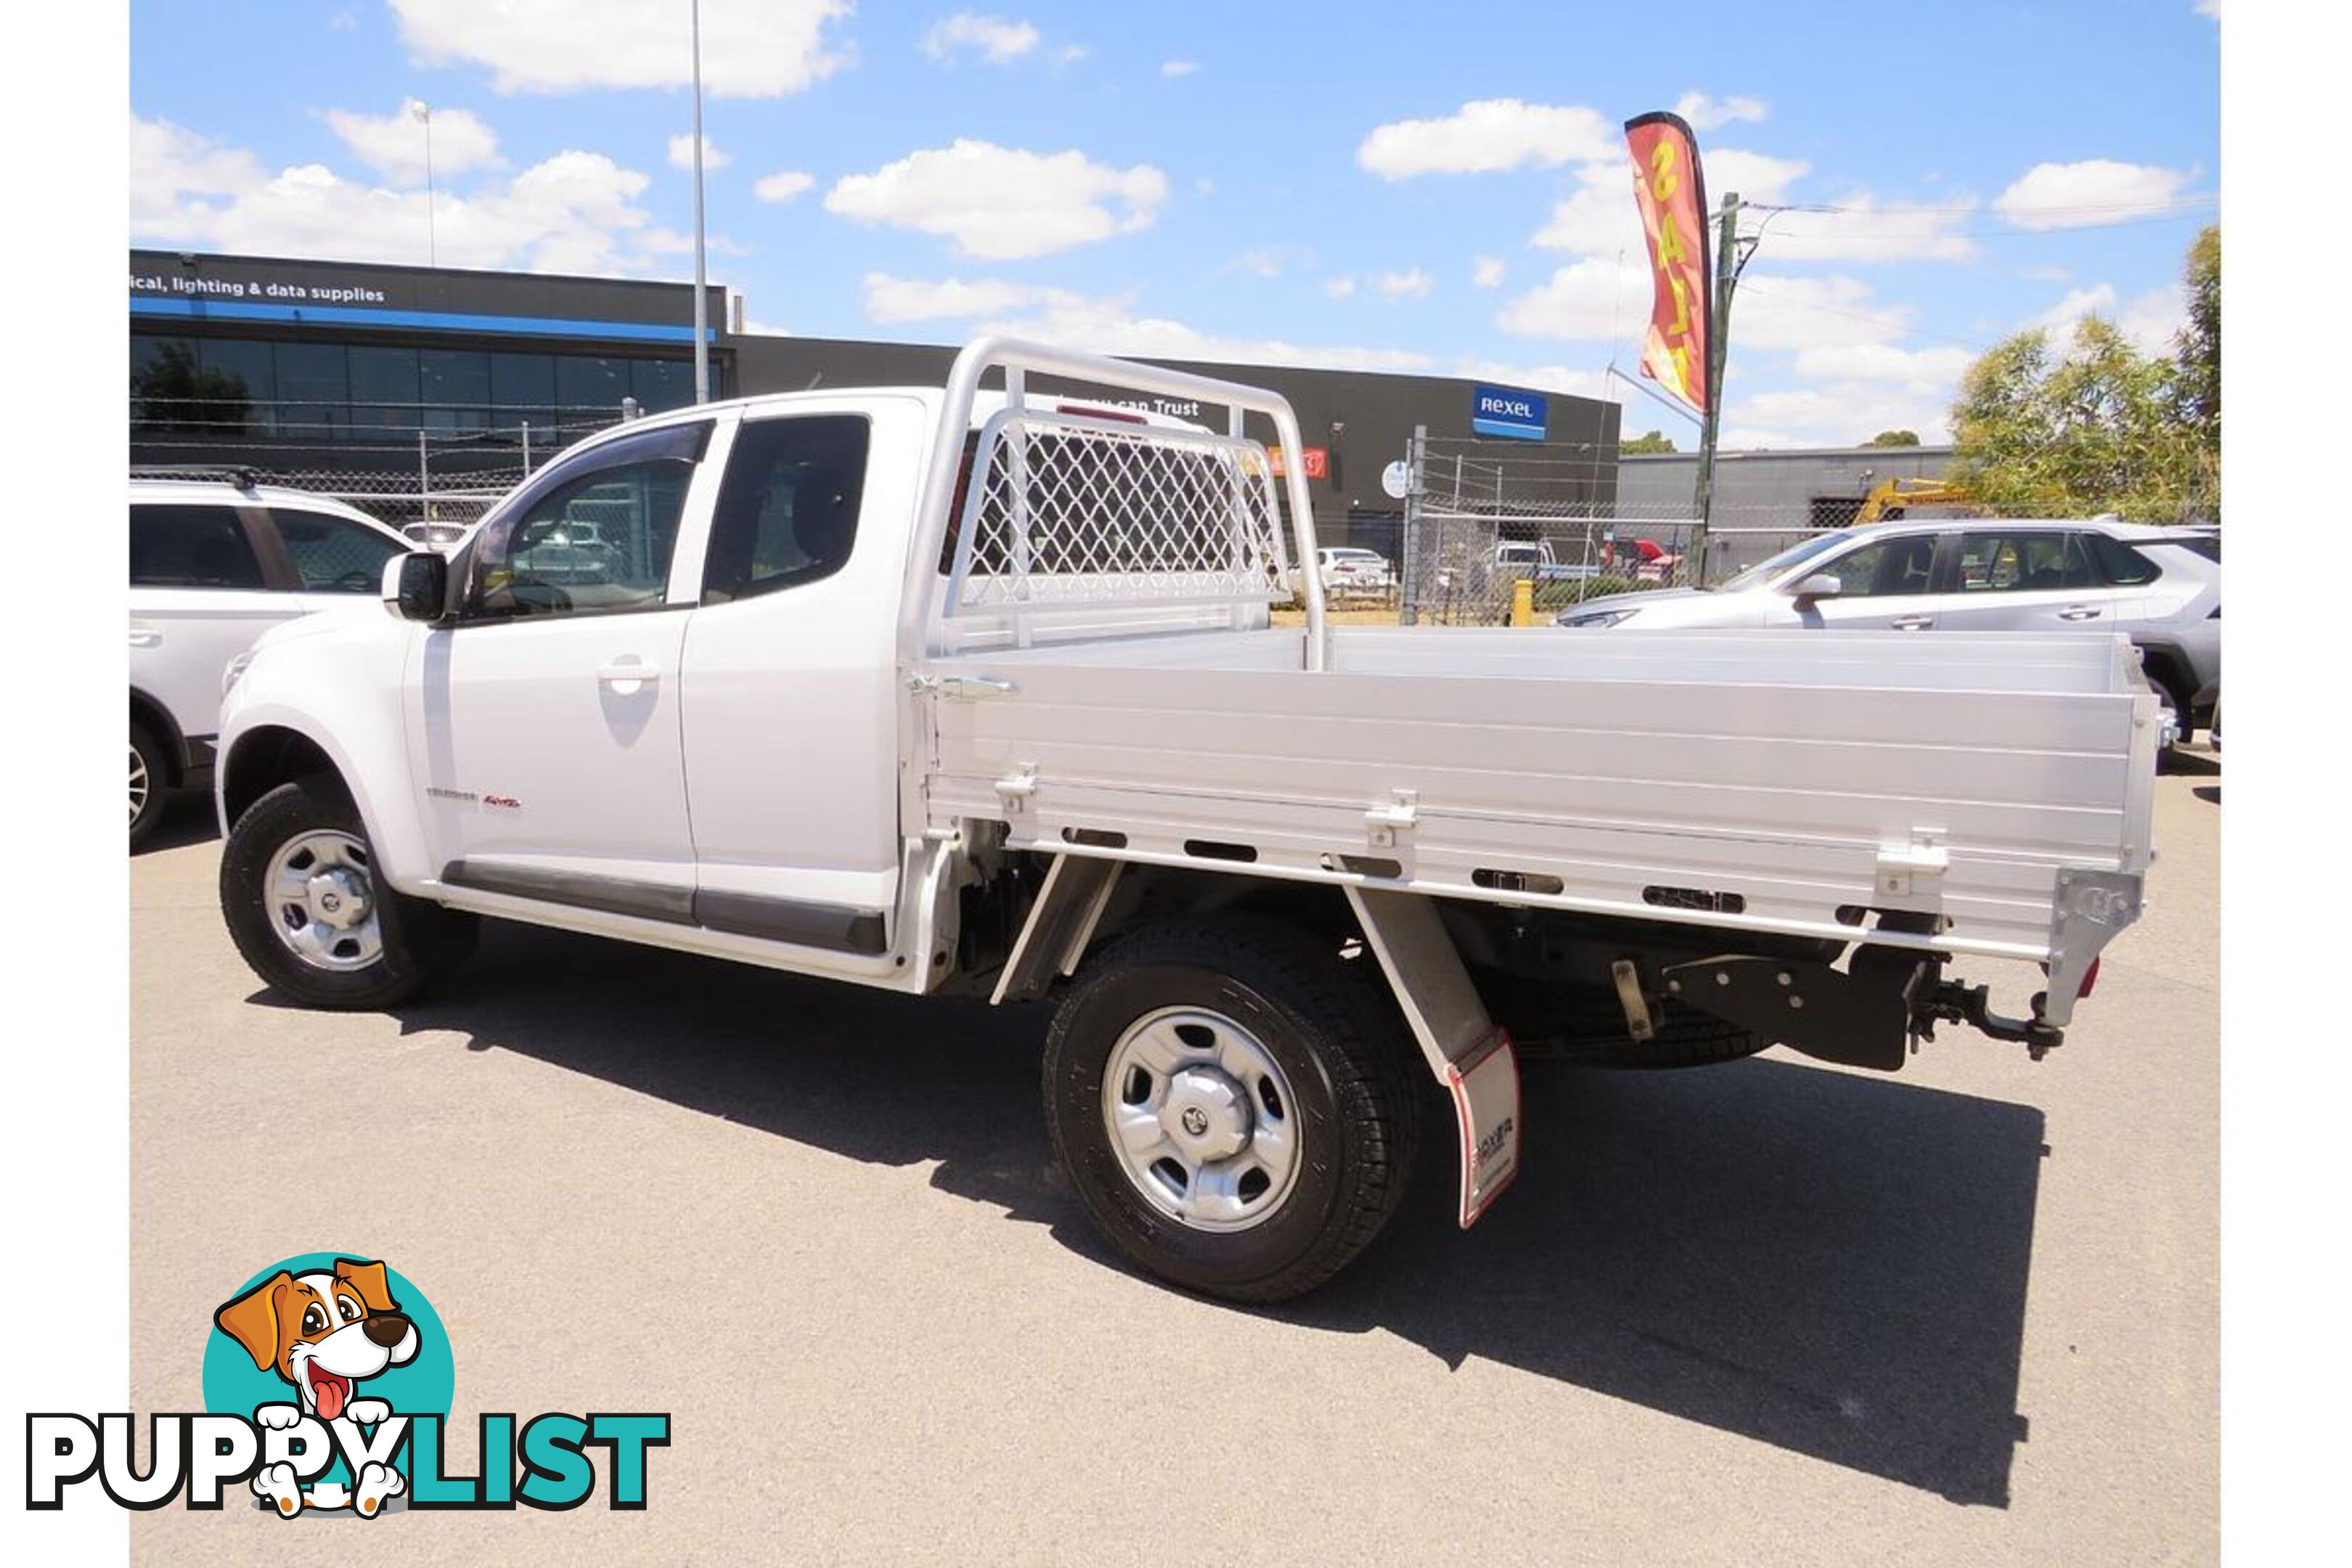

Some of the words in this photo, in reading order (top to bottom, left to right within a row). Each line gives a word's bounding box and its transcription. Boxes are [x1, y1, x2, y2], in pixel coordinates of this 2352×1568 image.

[172, 277, 244, 296] lighting
[249, 282, 261, 295] &
[266, 283, 306, 298] data
[311, 287, 385, 302] supplies
[1153, 399, 1199, 416] Trust
